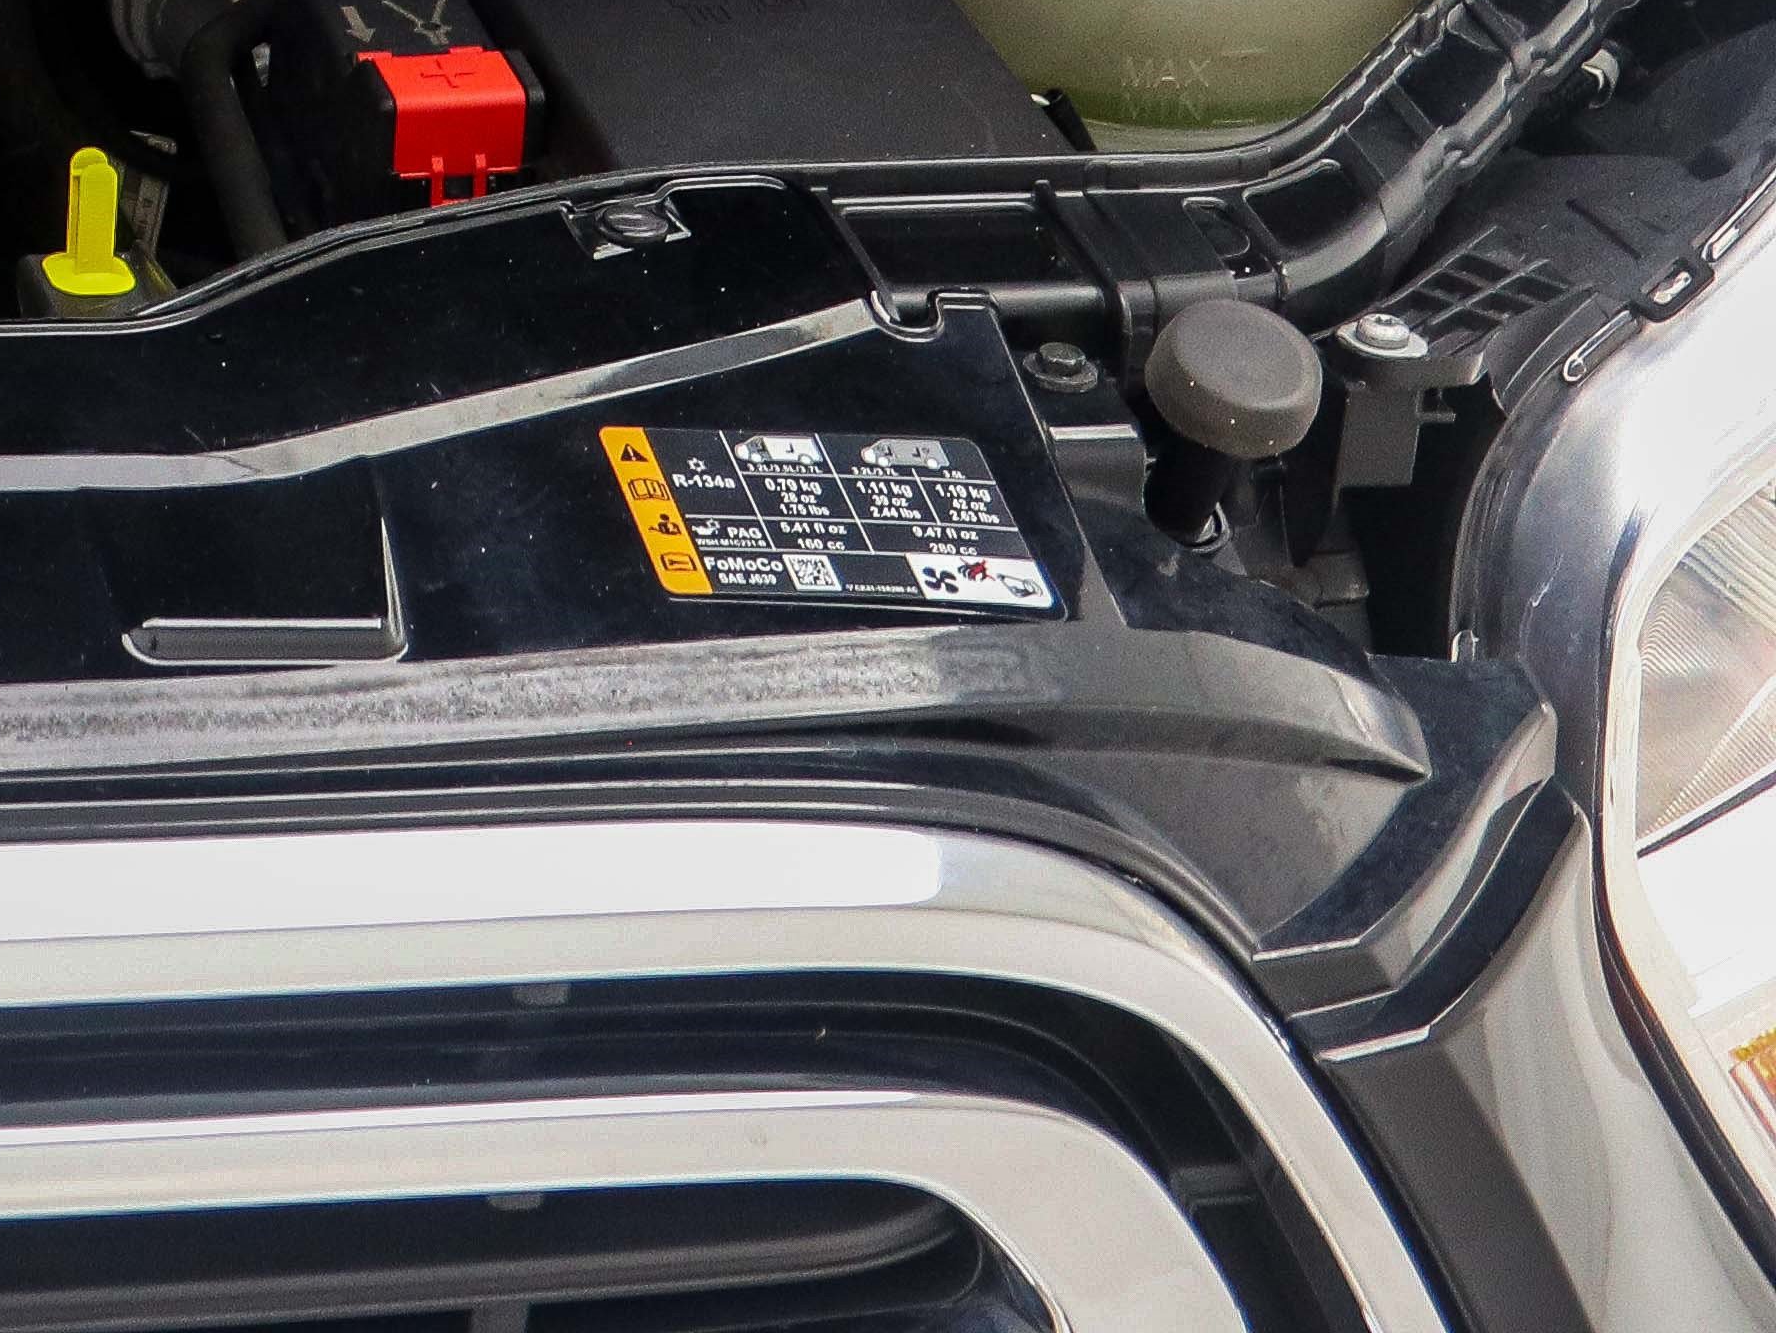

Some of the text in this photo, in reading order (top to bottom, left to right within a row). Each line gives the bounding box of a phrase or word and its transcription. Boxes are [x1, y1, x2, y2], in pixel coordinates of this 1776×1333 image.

[1122, 57, 1211, 88] MAX
[671, 473, 736, 489] R-134a
[764, 478, 822, 495] 0.79 kg
[856, 480, 913, 498] 1.11 kg
[935, 483, 991, 503] 1.19 kg
[800, 494, 817, 504] oz
[891, 497, 909, 507] oz
[952, 498, 987, 511] 42 oz
[808, 504, 830, 516] lbs
[870, 506, 922, 519] 2.44 lbs
[978, 511, 1000, 524] lbs
[727, 526, 763, 539] PAG
[828, 524, 847, 535] oz
[960, 530, 979, 541] oz
[797, 538, 846, 550] 160 cc
[929, 542, 978, 556] 280 cc
[704, 555, 784, 572] FoMoCo
[718, 572, 777, 584] SAE J639
